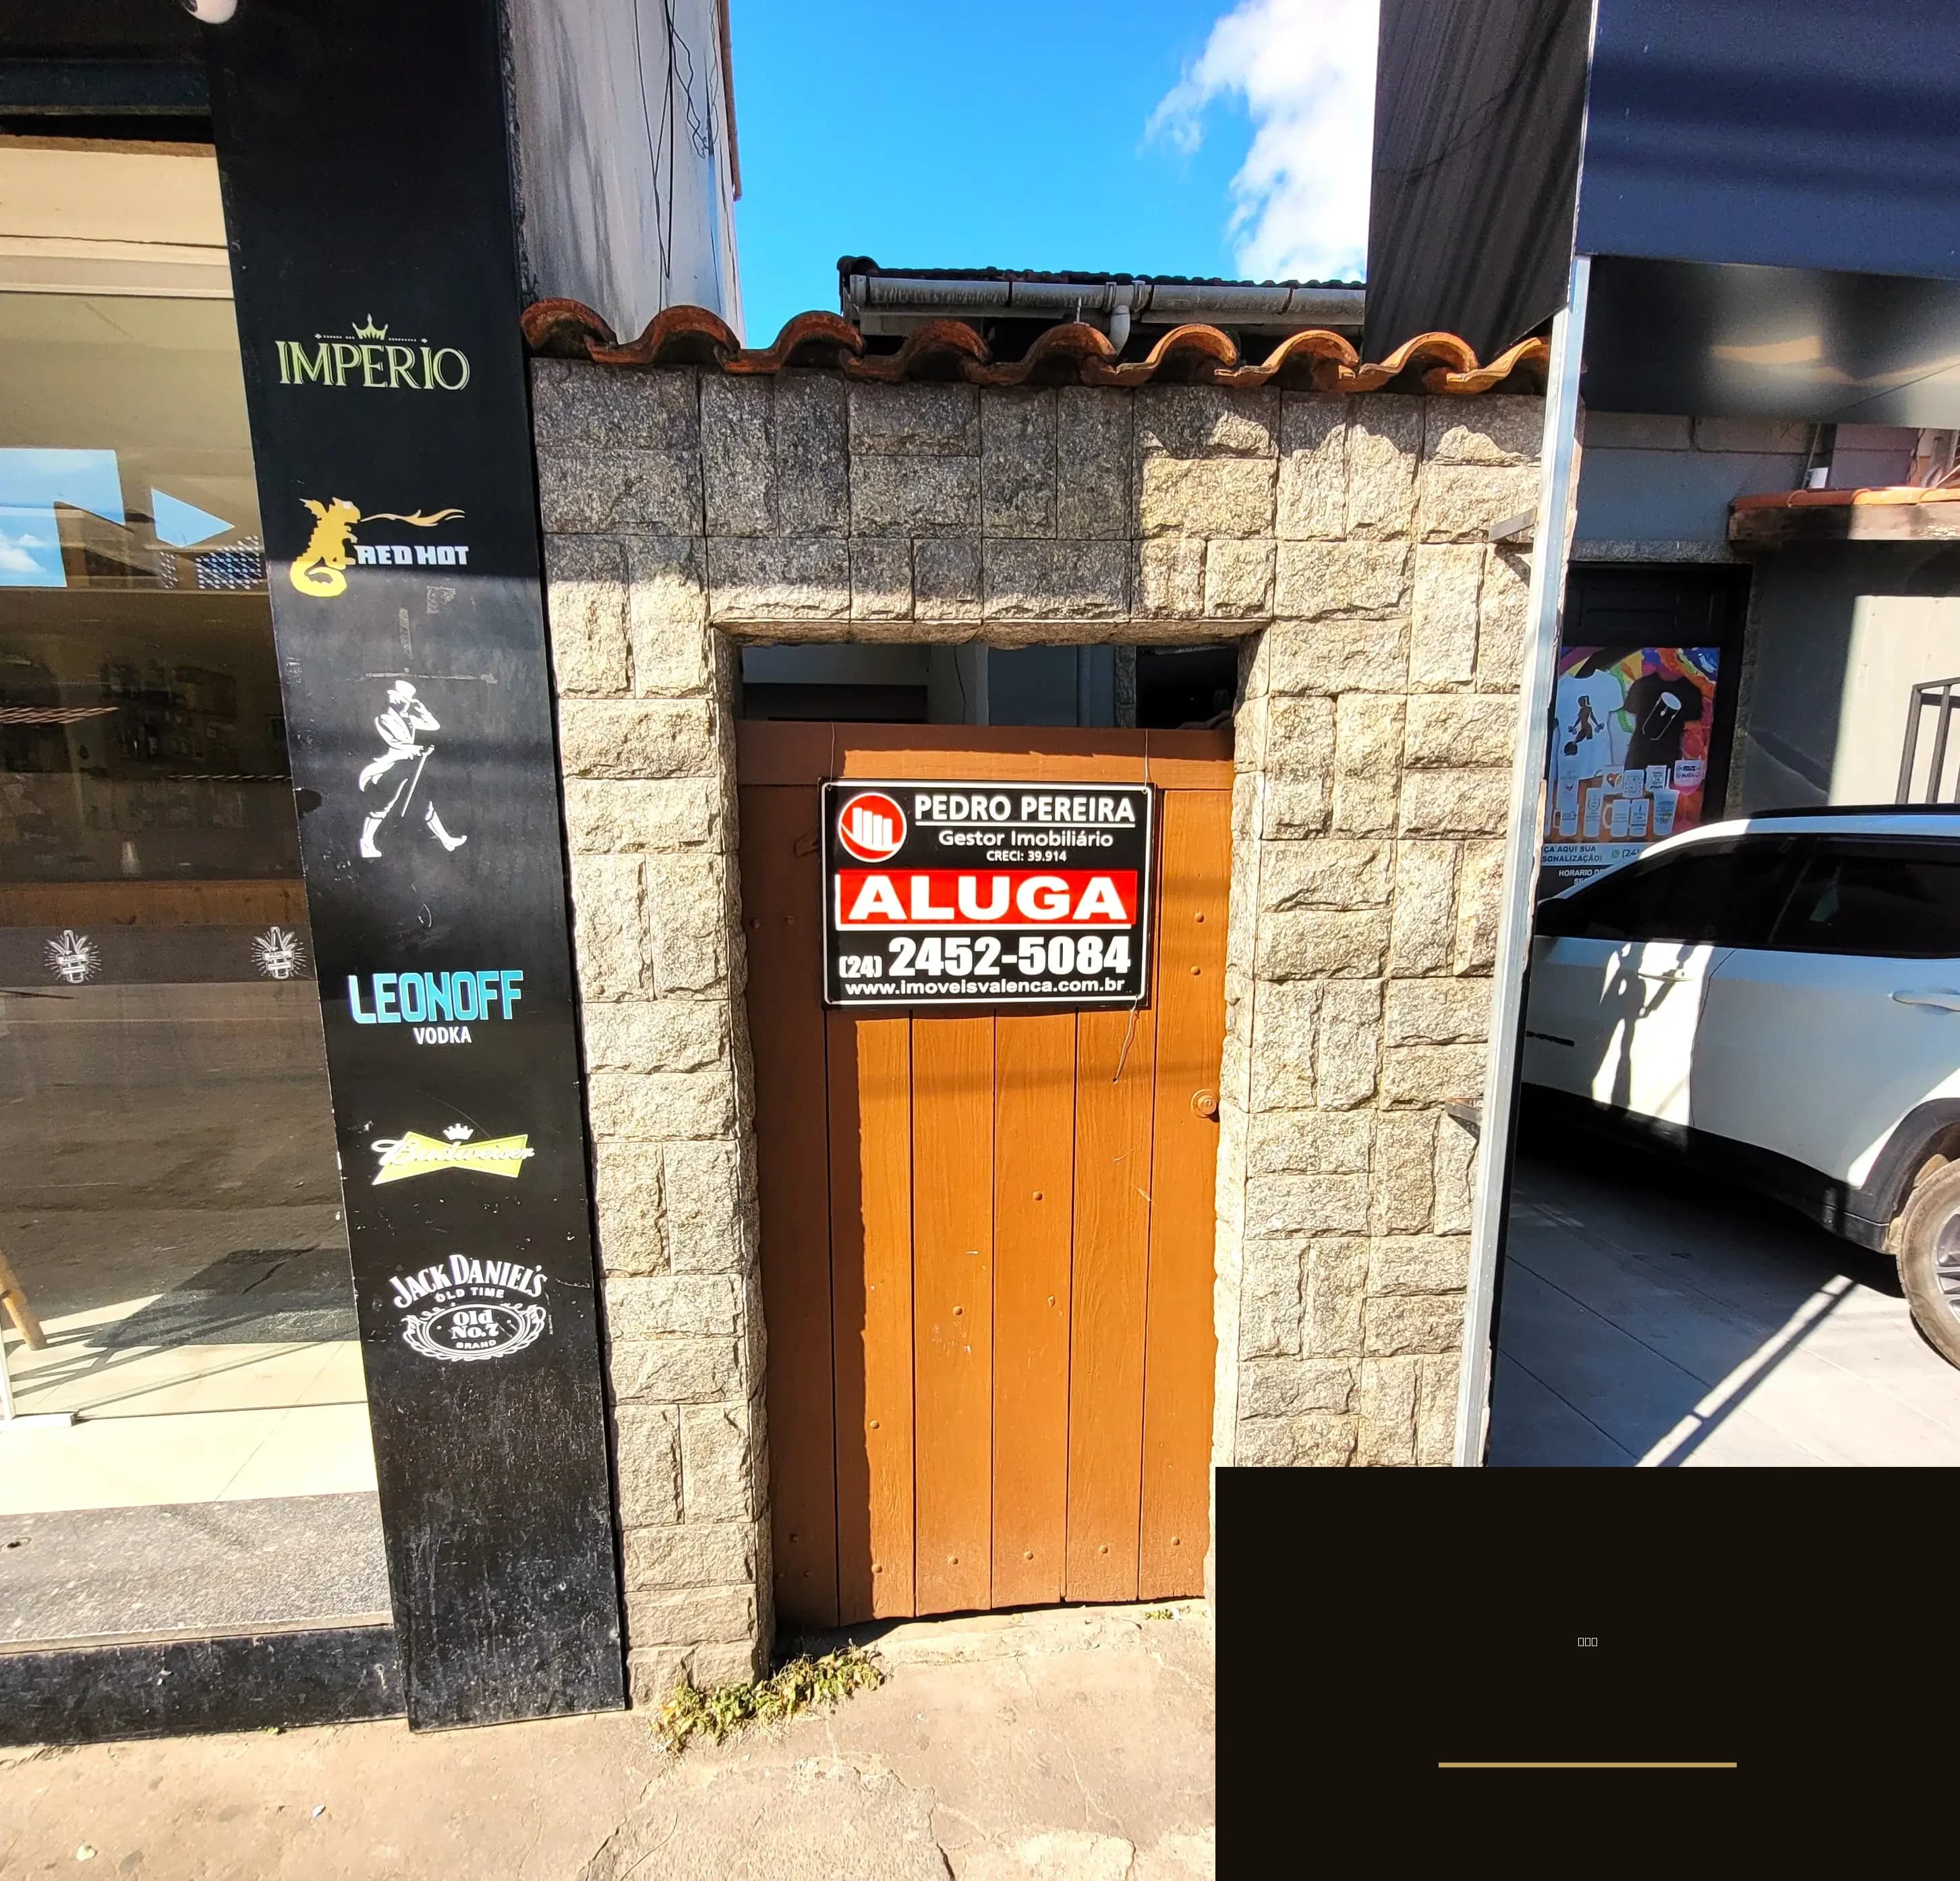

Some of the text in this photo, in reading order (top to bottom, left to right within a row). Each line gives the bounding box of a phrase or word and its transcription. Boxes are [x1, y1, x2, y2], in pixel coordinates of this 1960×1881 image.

[275, 341, 471, 390] IMPERIO
[354, 545, 469, 565] RED HOT
[915, 794, 1135, 822] PEDRO PEREIRA
[938, 830, 1114, 848] Gestor Imobiliário
[987, 850, 1066, 863] CRECI: 39.914
[1543, 854, 1603, 863] SONALIZAÇÃO!
[848, 875, 1127, 921] ALUGA
[839, 935, 1131, 978] (24) 2452-5084
[845, 977, 1125, 995] www.imoveisvalenca.com.br
[348, 970, 524, 1024] LEONOFF
[413, 1026, 473, 1045] VODKA
[389, 1254, 548, 1308] JACK DANIEL'S
[436, 1287, 505, 1302] OLD TIME
[453, 1309, 494, 1326] Old
[456, 1339, 497, 1349] BRAND
